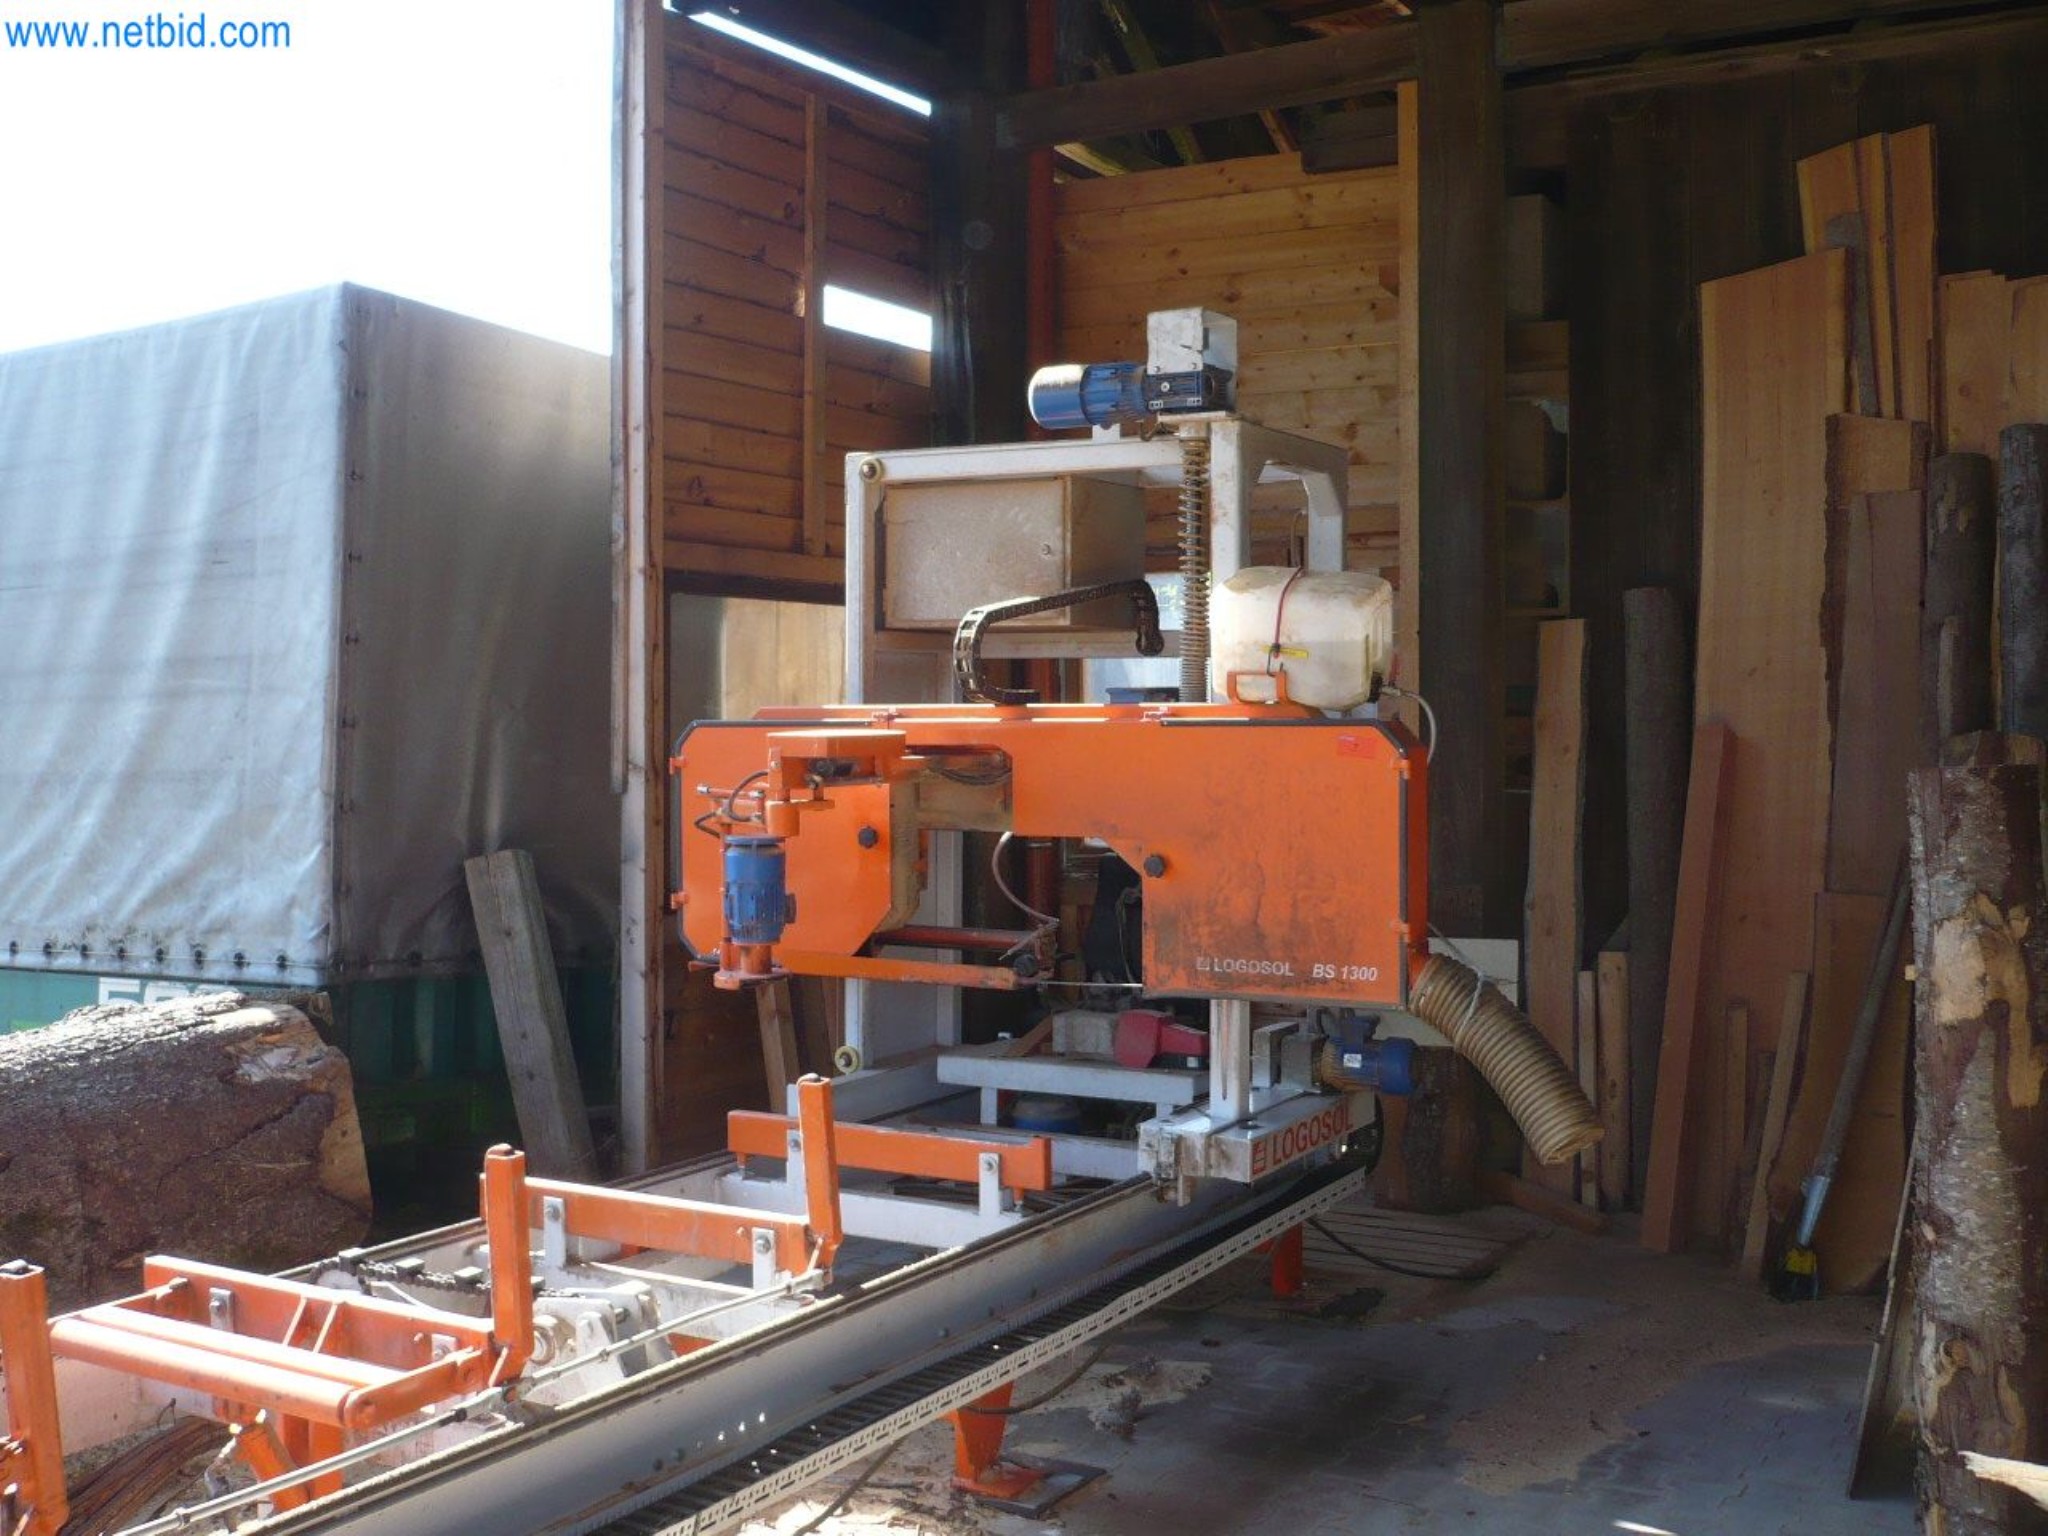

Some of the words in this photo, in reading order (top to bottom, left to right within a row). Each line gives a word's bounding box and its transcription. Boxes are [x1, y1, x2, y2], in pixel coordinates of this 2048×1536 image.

[1213, 958, 1295, 977] LOGOSOL
[1312, 963, 1336, 979] BS
[1341, 965, 1378, 982] 1300
[1271, 1096, 1354, 1166] LOGOSOL
